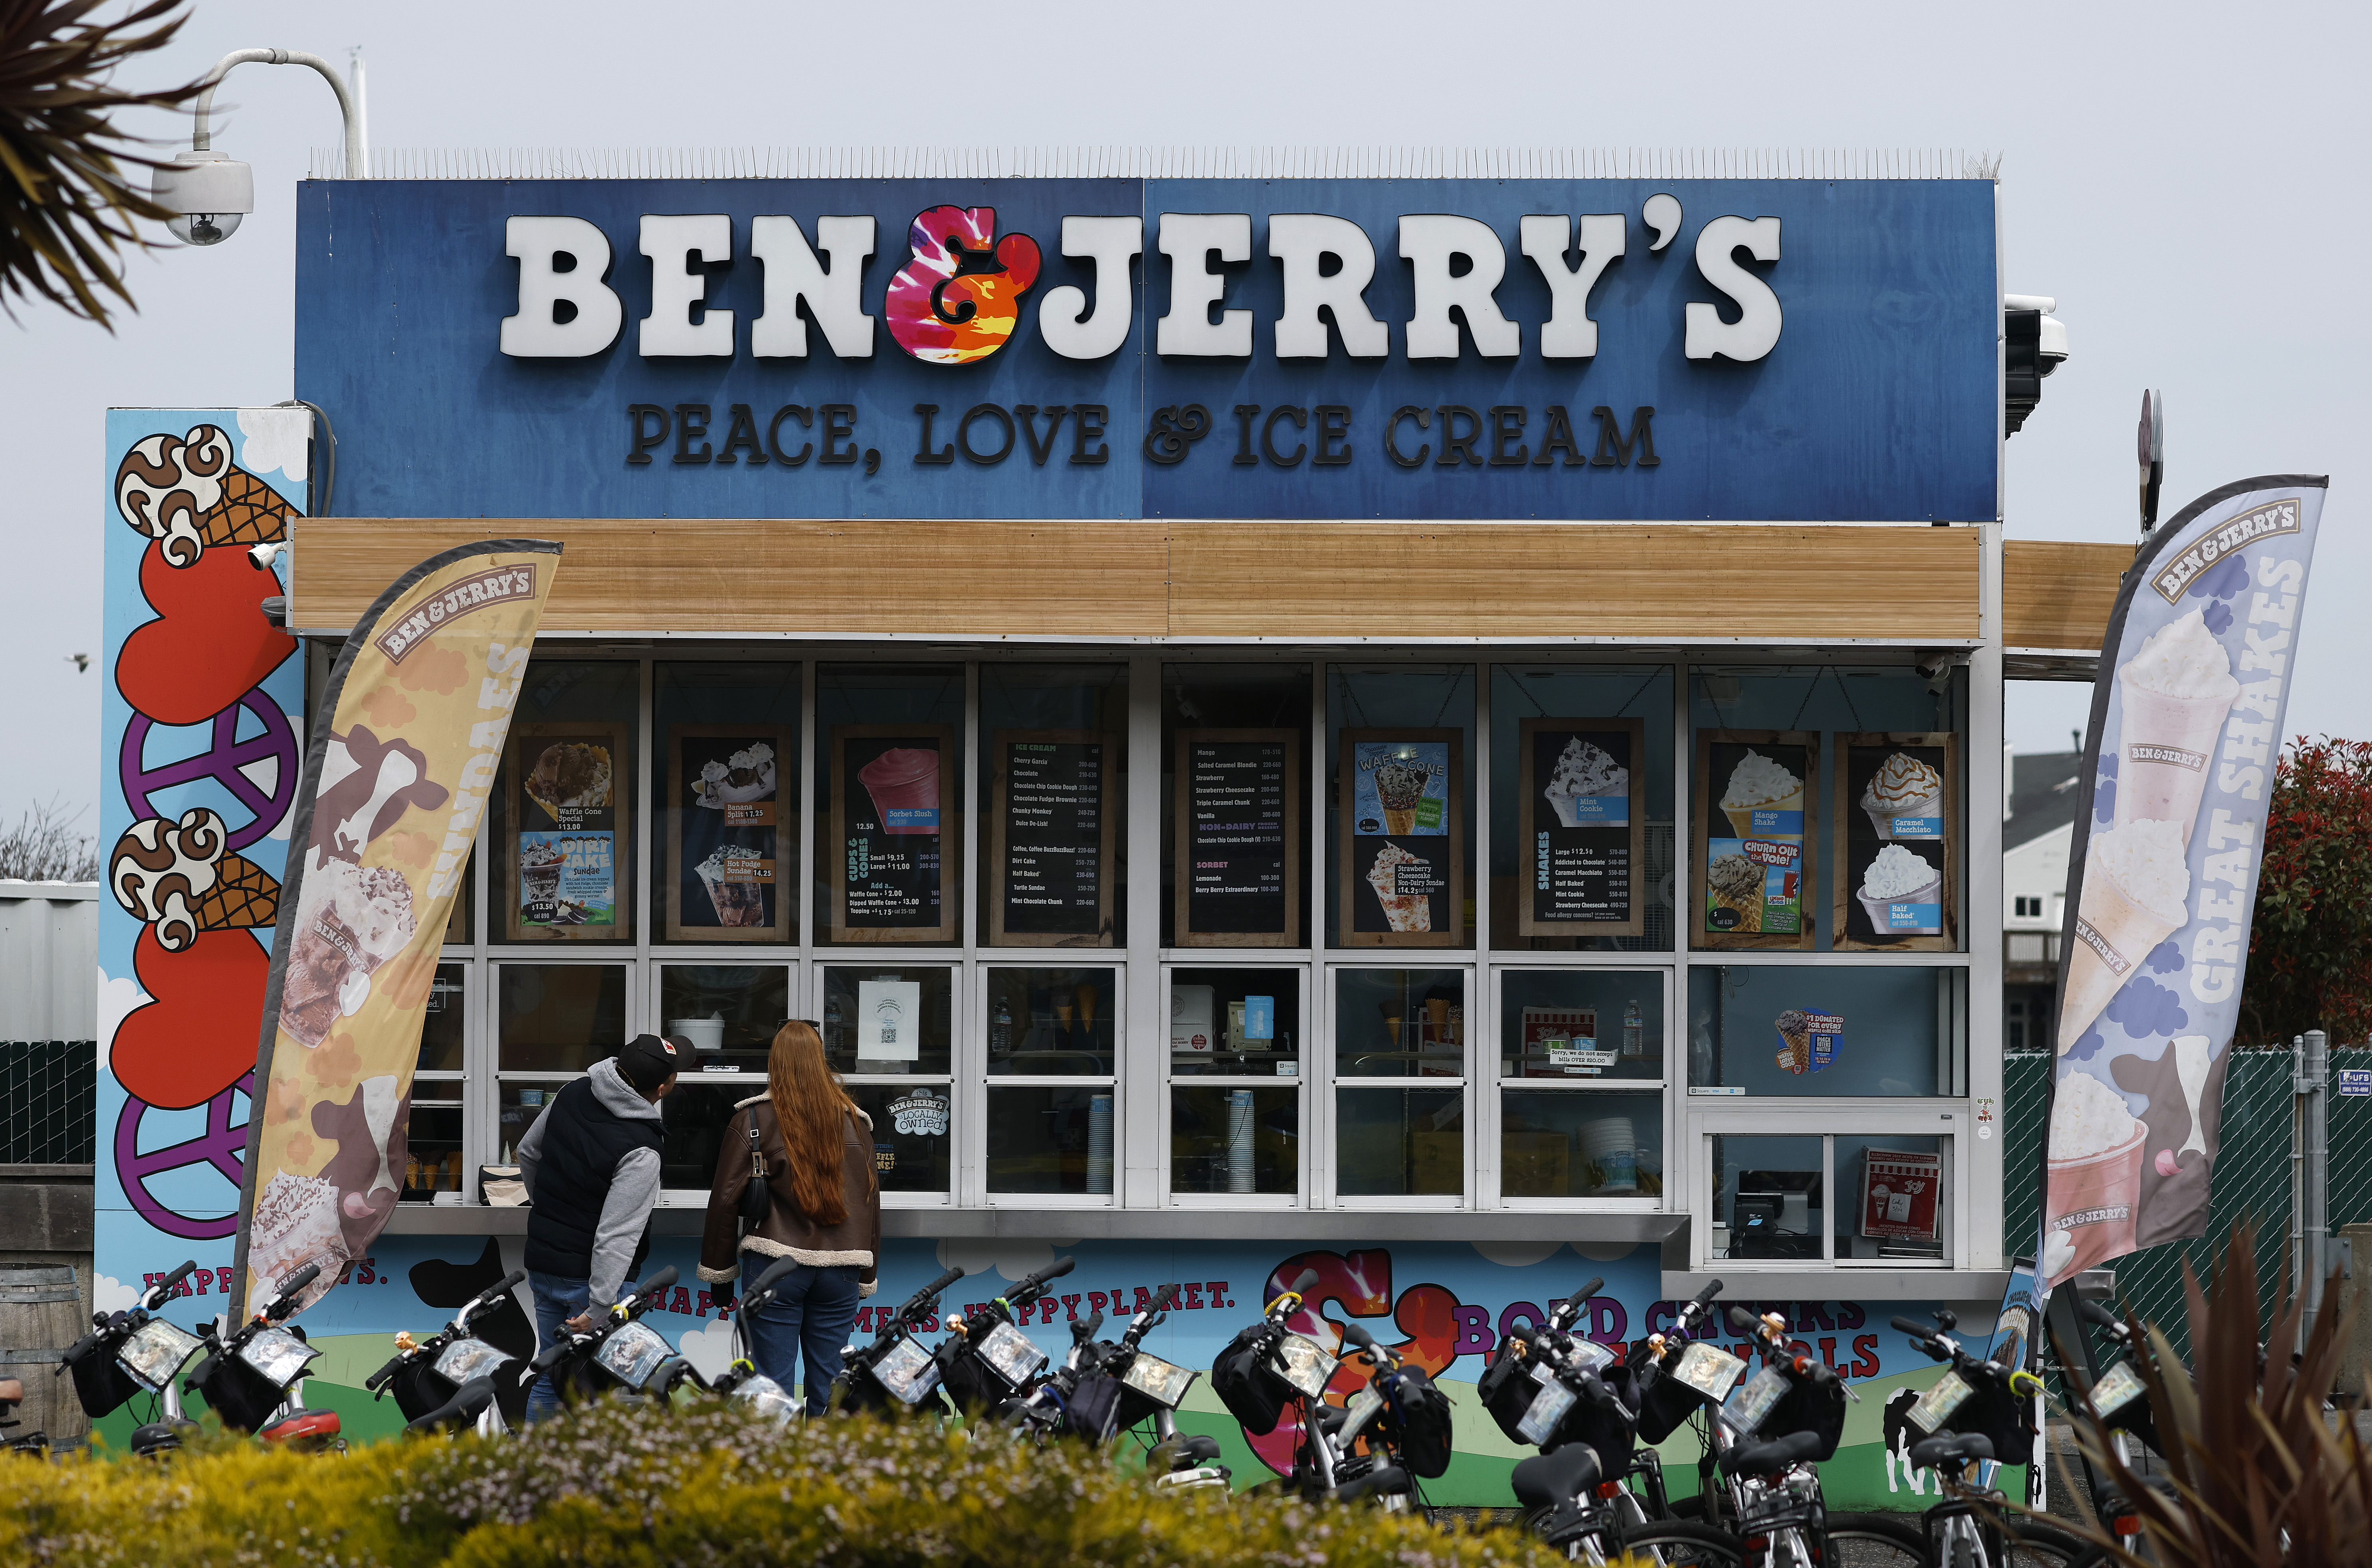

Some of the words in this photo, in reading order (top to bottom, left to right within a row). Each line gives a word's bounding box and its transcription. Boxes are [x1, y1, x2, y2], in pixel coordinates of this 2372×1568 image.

[625, 404, 883, 478] PEACE,
[914, 404, 1111, 468] LOVE
[1143, 404, 1212, 467] &
[1231, 404, 1354, 467] ICE
[1385, 404, 1662, 468] CREAM
[2218, 556, 2303, 800] SHAKES
[1407, 760, 1445, 776] CONE
[560, 836, 611, 853] DIRT
[848, 838, 857, 847] &
[562, 853, 611, 867] CAKE
[848, 849, 858, 881] CUPS
[859, 837, 868, 878] CONES
[1538, 831, 1549, 890] SHAKES
[2190, 809, 2254, 1004] GREAT
[900, 1118, 943, 1131] owned.
[902, 1110, 942, 1120] LOCALLY
